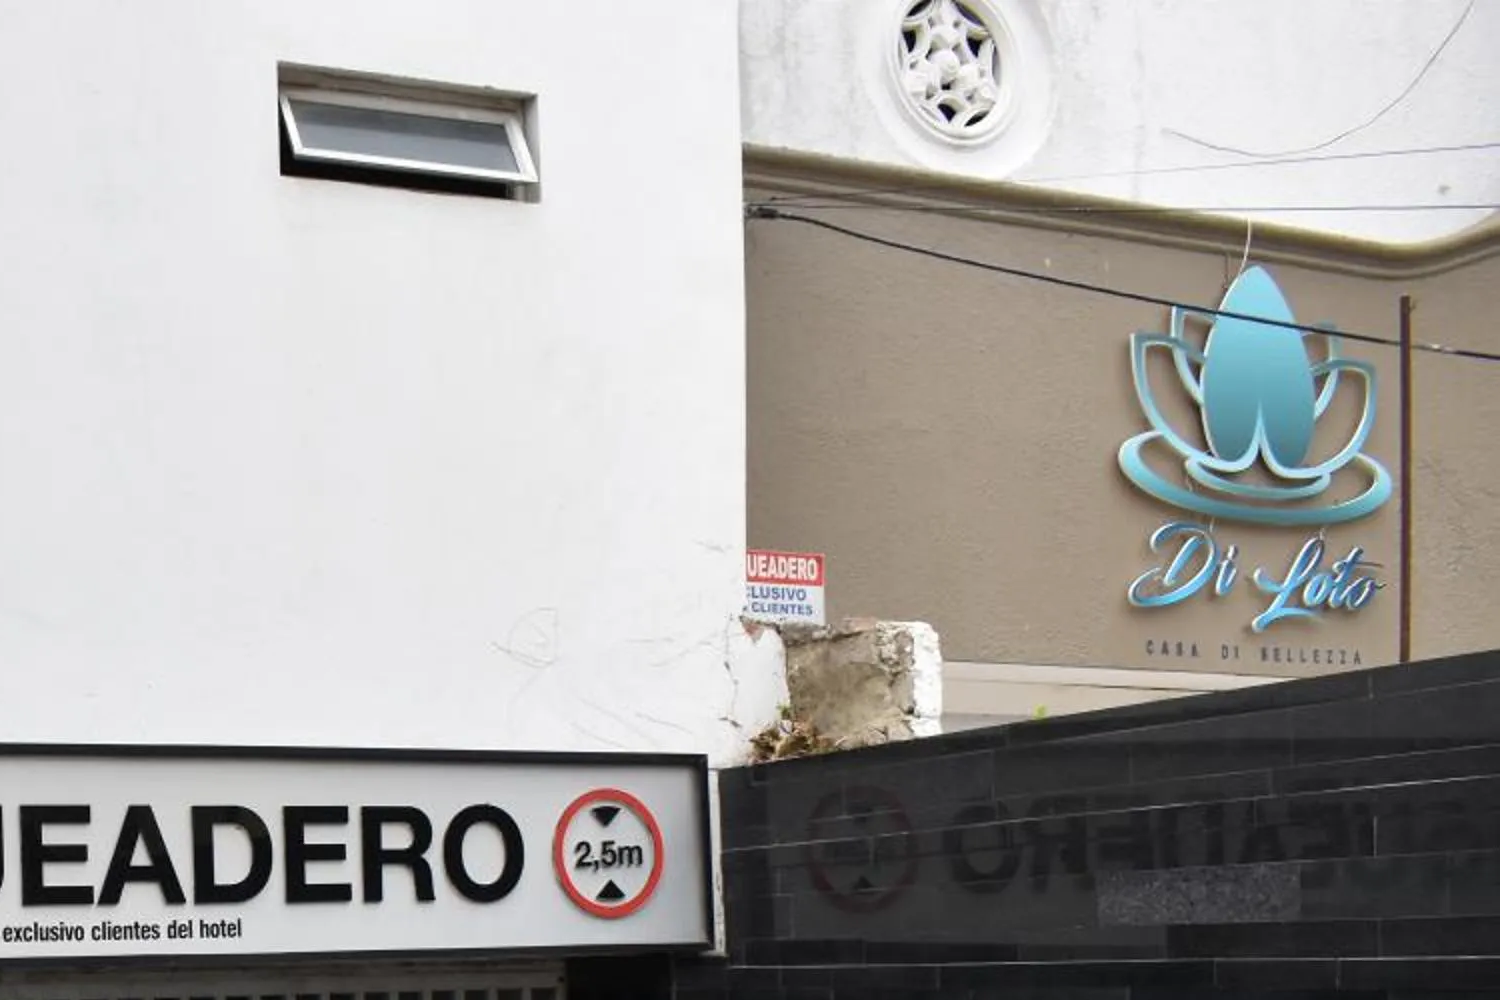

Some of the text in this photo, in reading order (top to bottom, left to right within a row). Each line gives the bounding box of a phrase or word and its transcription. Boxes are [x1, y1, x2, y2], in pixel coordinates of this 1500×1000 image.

[747, 553, 818, 580] UEADERO
[1127, 521, 1387, 634] Di Loto
[751, 602, 813, 616] CLIENTES
[1146, 640, 1362, 665] CASA DI BELLEZZA
[573, 840, 644, 870] 2,5m
[2, 921, 85, 942] exclusivo
[91, 920, 160, 941] clientes
[167, 919, 193, 938] del
[200, 918, 242, 939] hotel
